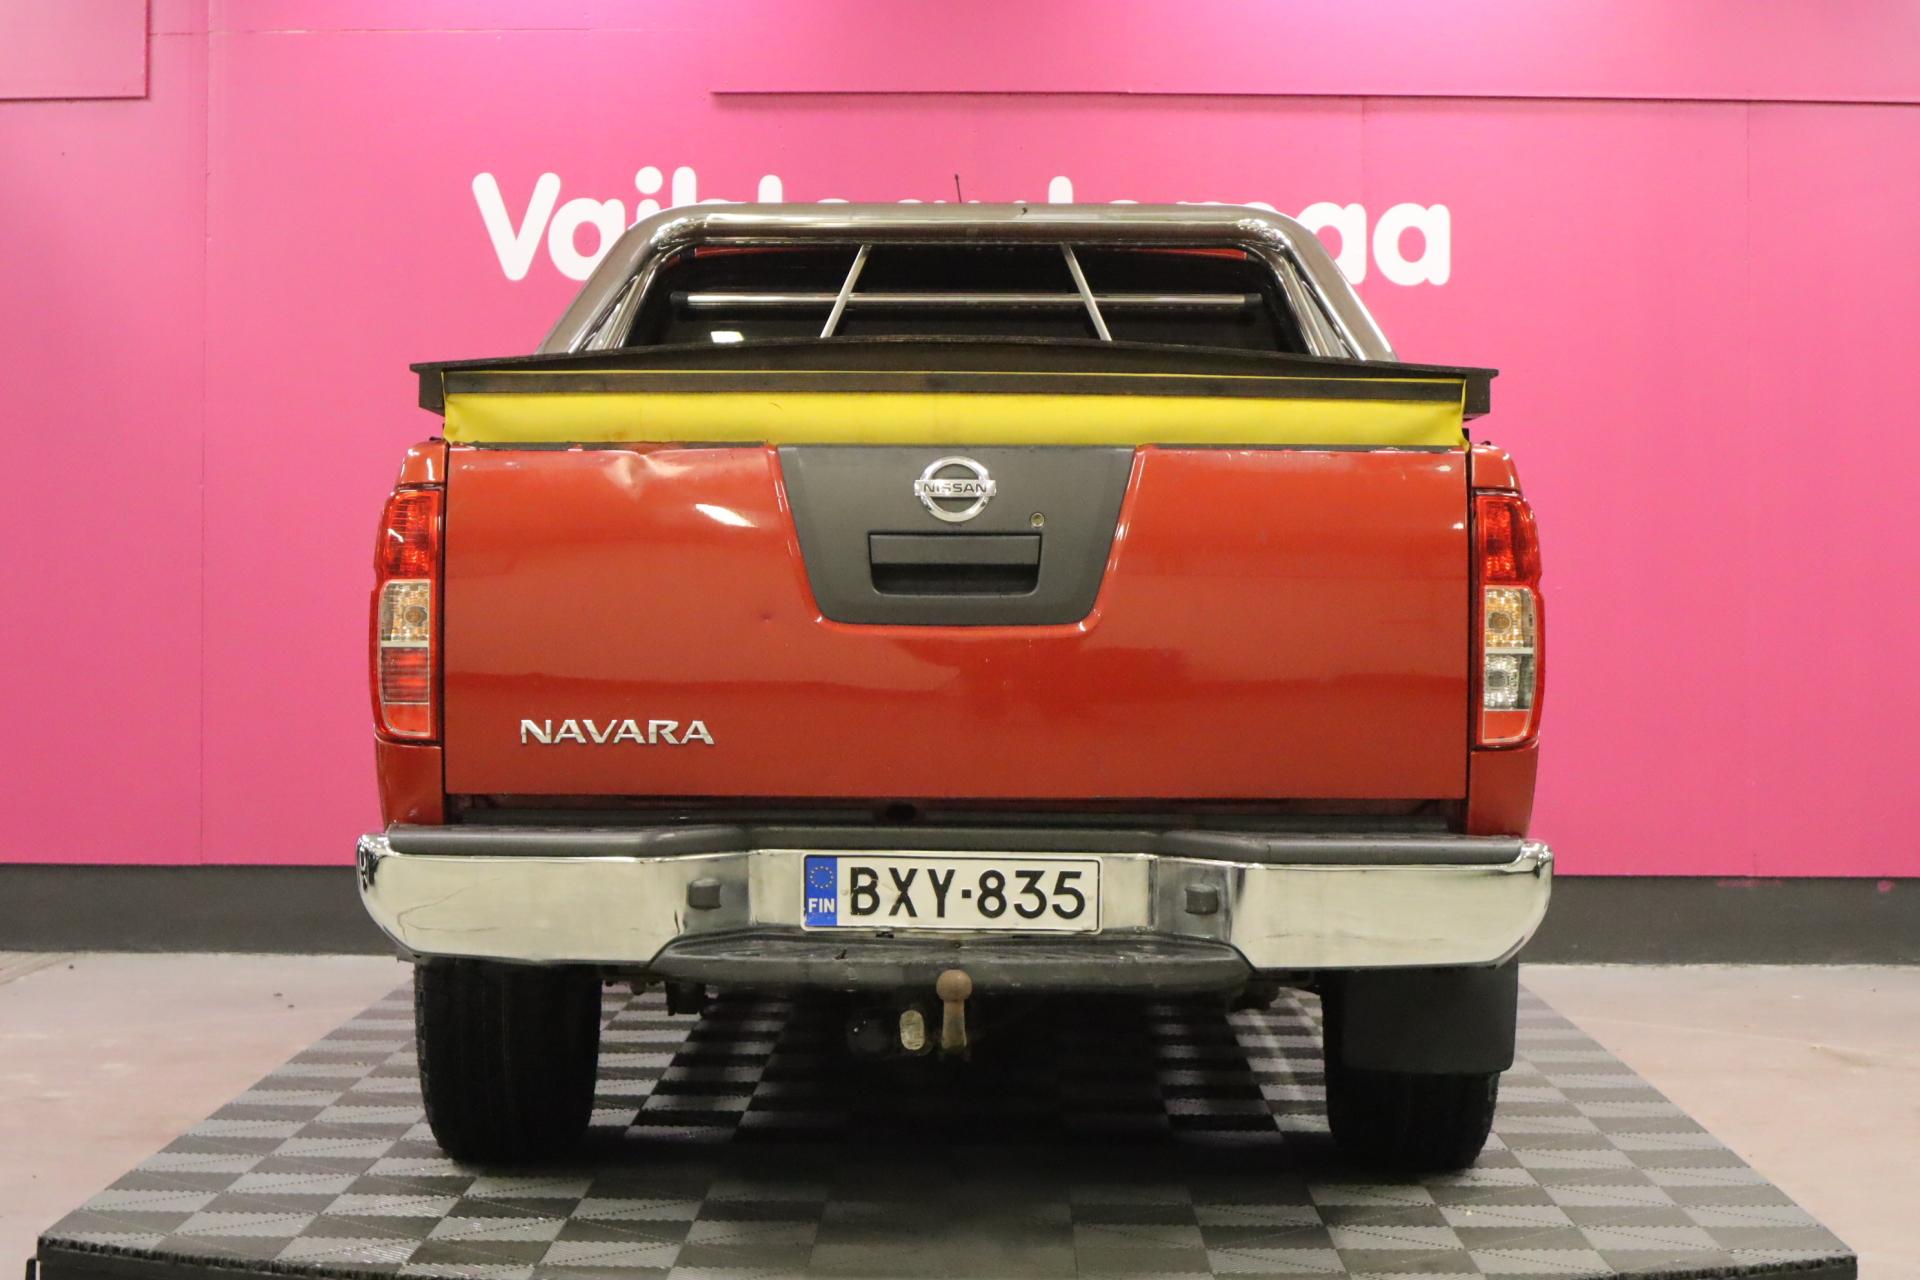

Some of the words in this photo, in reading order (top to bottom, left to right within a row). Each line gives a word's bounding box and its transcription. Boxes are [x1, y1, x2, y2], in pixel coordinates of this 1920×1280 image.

[923, 483, 987, 493] NISSAN
[520, 719, 715, 745] NAVARA
[850, 866, 1086, 919] BXY-835
[808, 897, 835, 913] FIN
